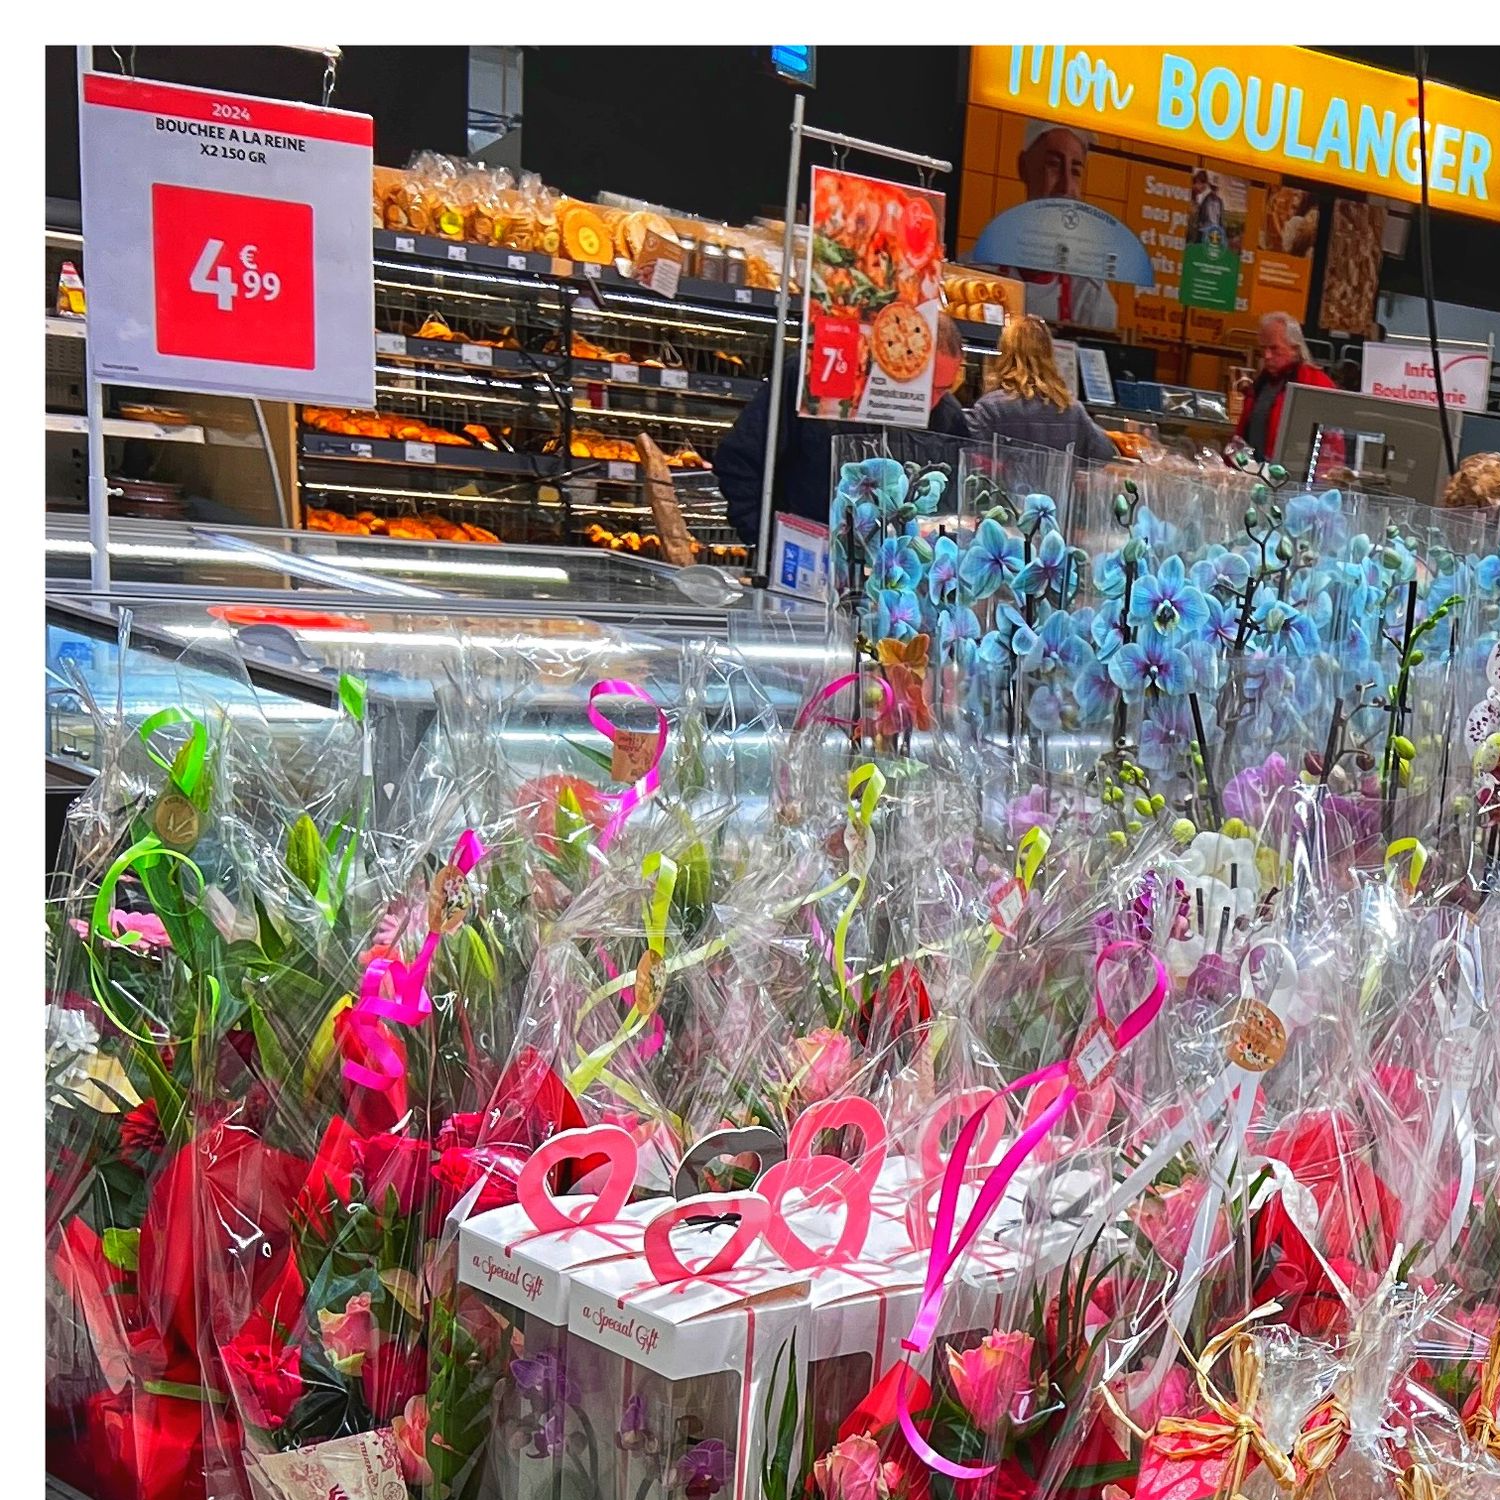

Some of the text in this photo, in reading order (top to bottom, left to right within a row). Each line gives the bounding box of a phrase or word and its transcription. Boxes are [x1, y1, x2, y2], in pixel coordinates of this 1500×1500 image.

[211, 102, 251, 121] 2024
[1009, 45, 1493, 201] Mon BOULANGER
[155, 117, 306, 152] BOUCHEE A LA REINE
[200, 143, 267, 164] X2 150 GR
[1404, 362, 1438, 378] Info
[1372, 382, 1467, 404] Boulangrie
[472, 1255, 545, 1301] a Special Gift
[583, 1307, 660, 1354] a Special Gift
